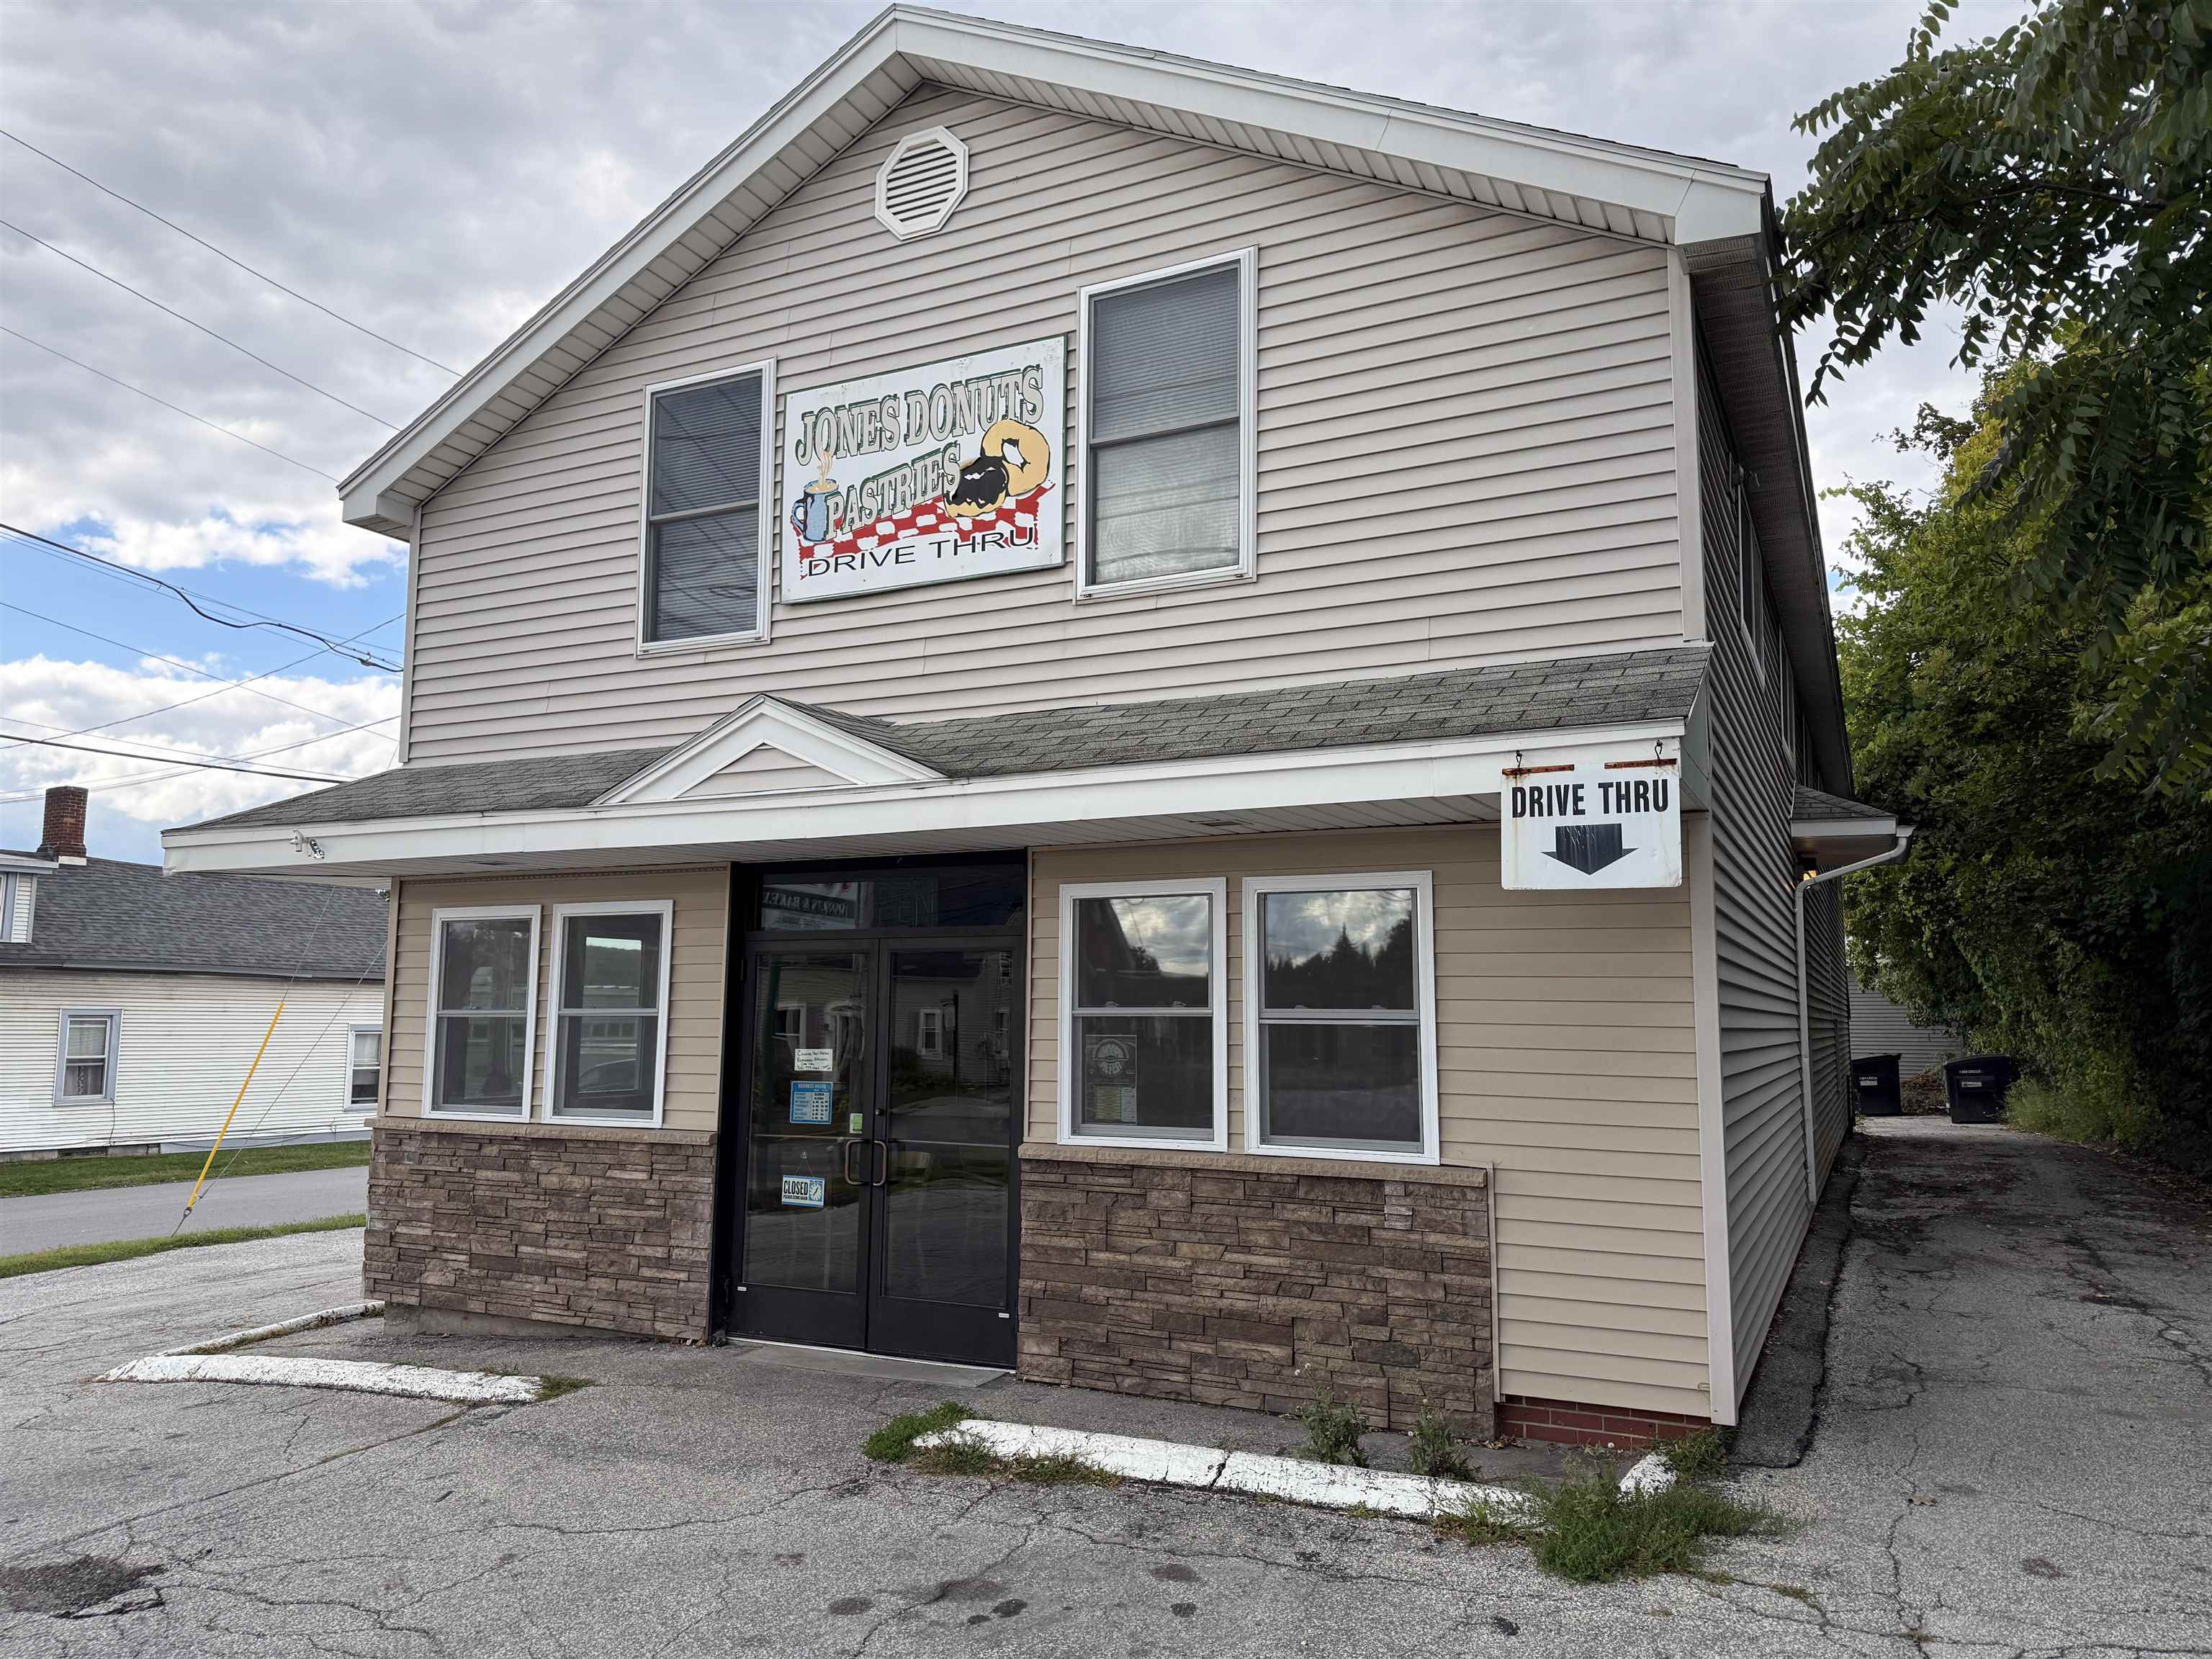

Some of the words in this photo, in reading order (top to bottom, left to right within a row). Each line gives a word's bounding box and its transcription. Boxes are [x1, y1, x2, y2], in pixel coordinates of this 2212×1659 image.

[795, 393, 900, 467] JONES
[904, 364, 1044, 446] DONUTS
[824, 441, 961, 541] PASTRIES
[808, 545, 915, 577] DRIVE
[928, 527, 1034, 559] THRU
[1511, 783, 1586, 819] DRIVE
[1598, 778, 1669, 814] THRU
[783, 1180, 808, 1195] CLOSED
